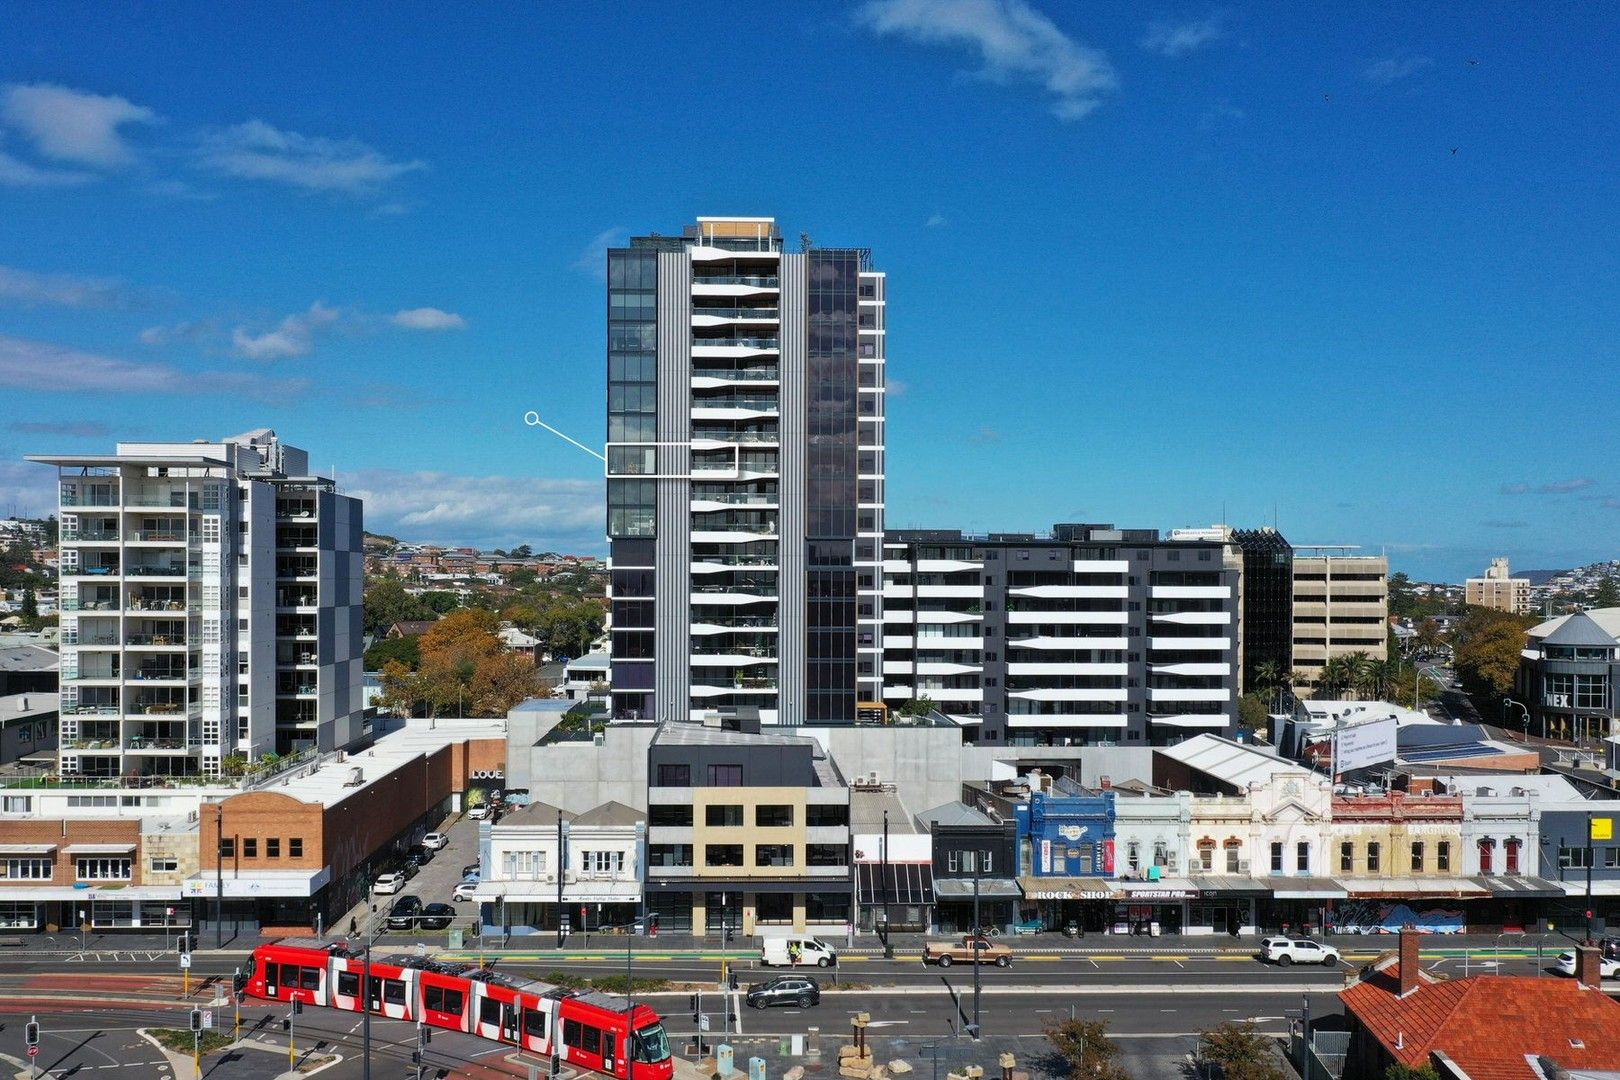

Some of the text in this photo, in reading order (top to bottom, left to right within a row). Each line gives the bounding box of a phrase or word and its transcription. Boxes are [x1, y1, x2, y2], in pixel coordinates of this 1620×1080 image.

[472, 770, 504, 779] LOVE
[1037, 891, 1112, 899] ROCK SHOP
[1131, 890, 1170, 898] SPORTSTAR
